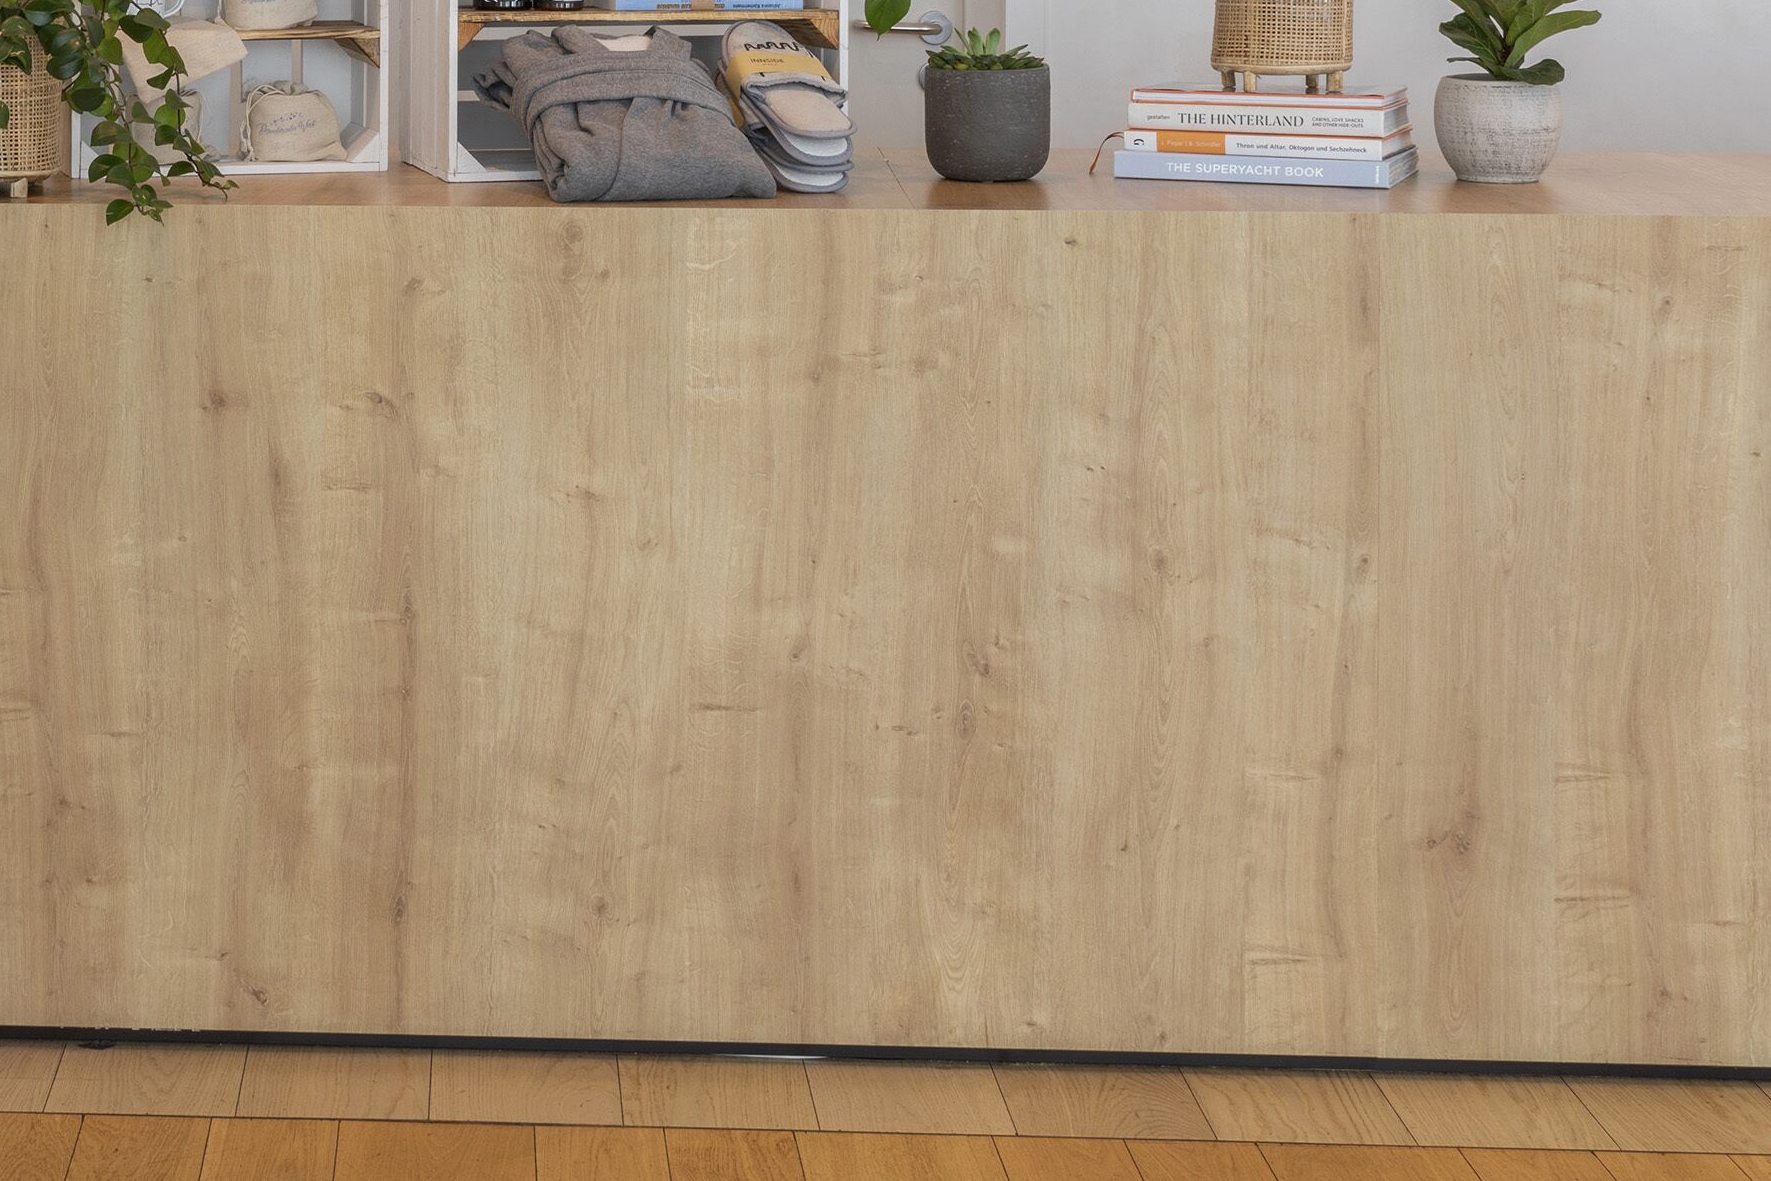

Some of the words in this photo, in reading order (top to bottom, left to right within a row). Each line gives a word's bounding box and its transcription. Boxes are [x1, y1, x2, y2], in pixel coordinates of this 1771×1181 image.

[1177, 112, 1207, 125] THE
[1210, 112, 1304, 128] HINTERLAND
[1288, 144, 1315, 153] Oktogon
[1329, 146, 1367, 154] Sechzehneck
[1166, 162, 1191, 173] THE
[1195, 163, 1281, 177] SUPERYACHT
[1284, 166, 1325, 178] BOOK
